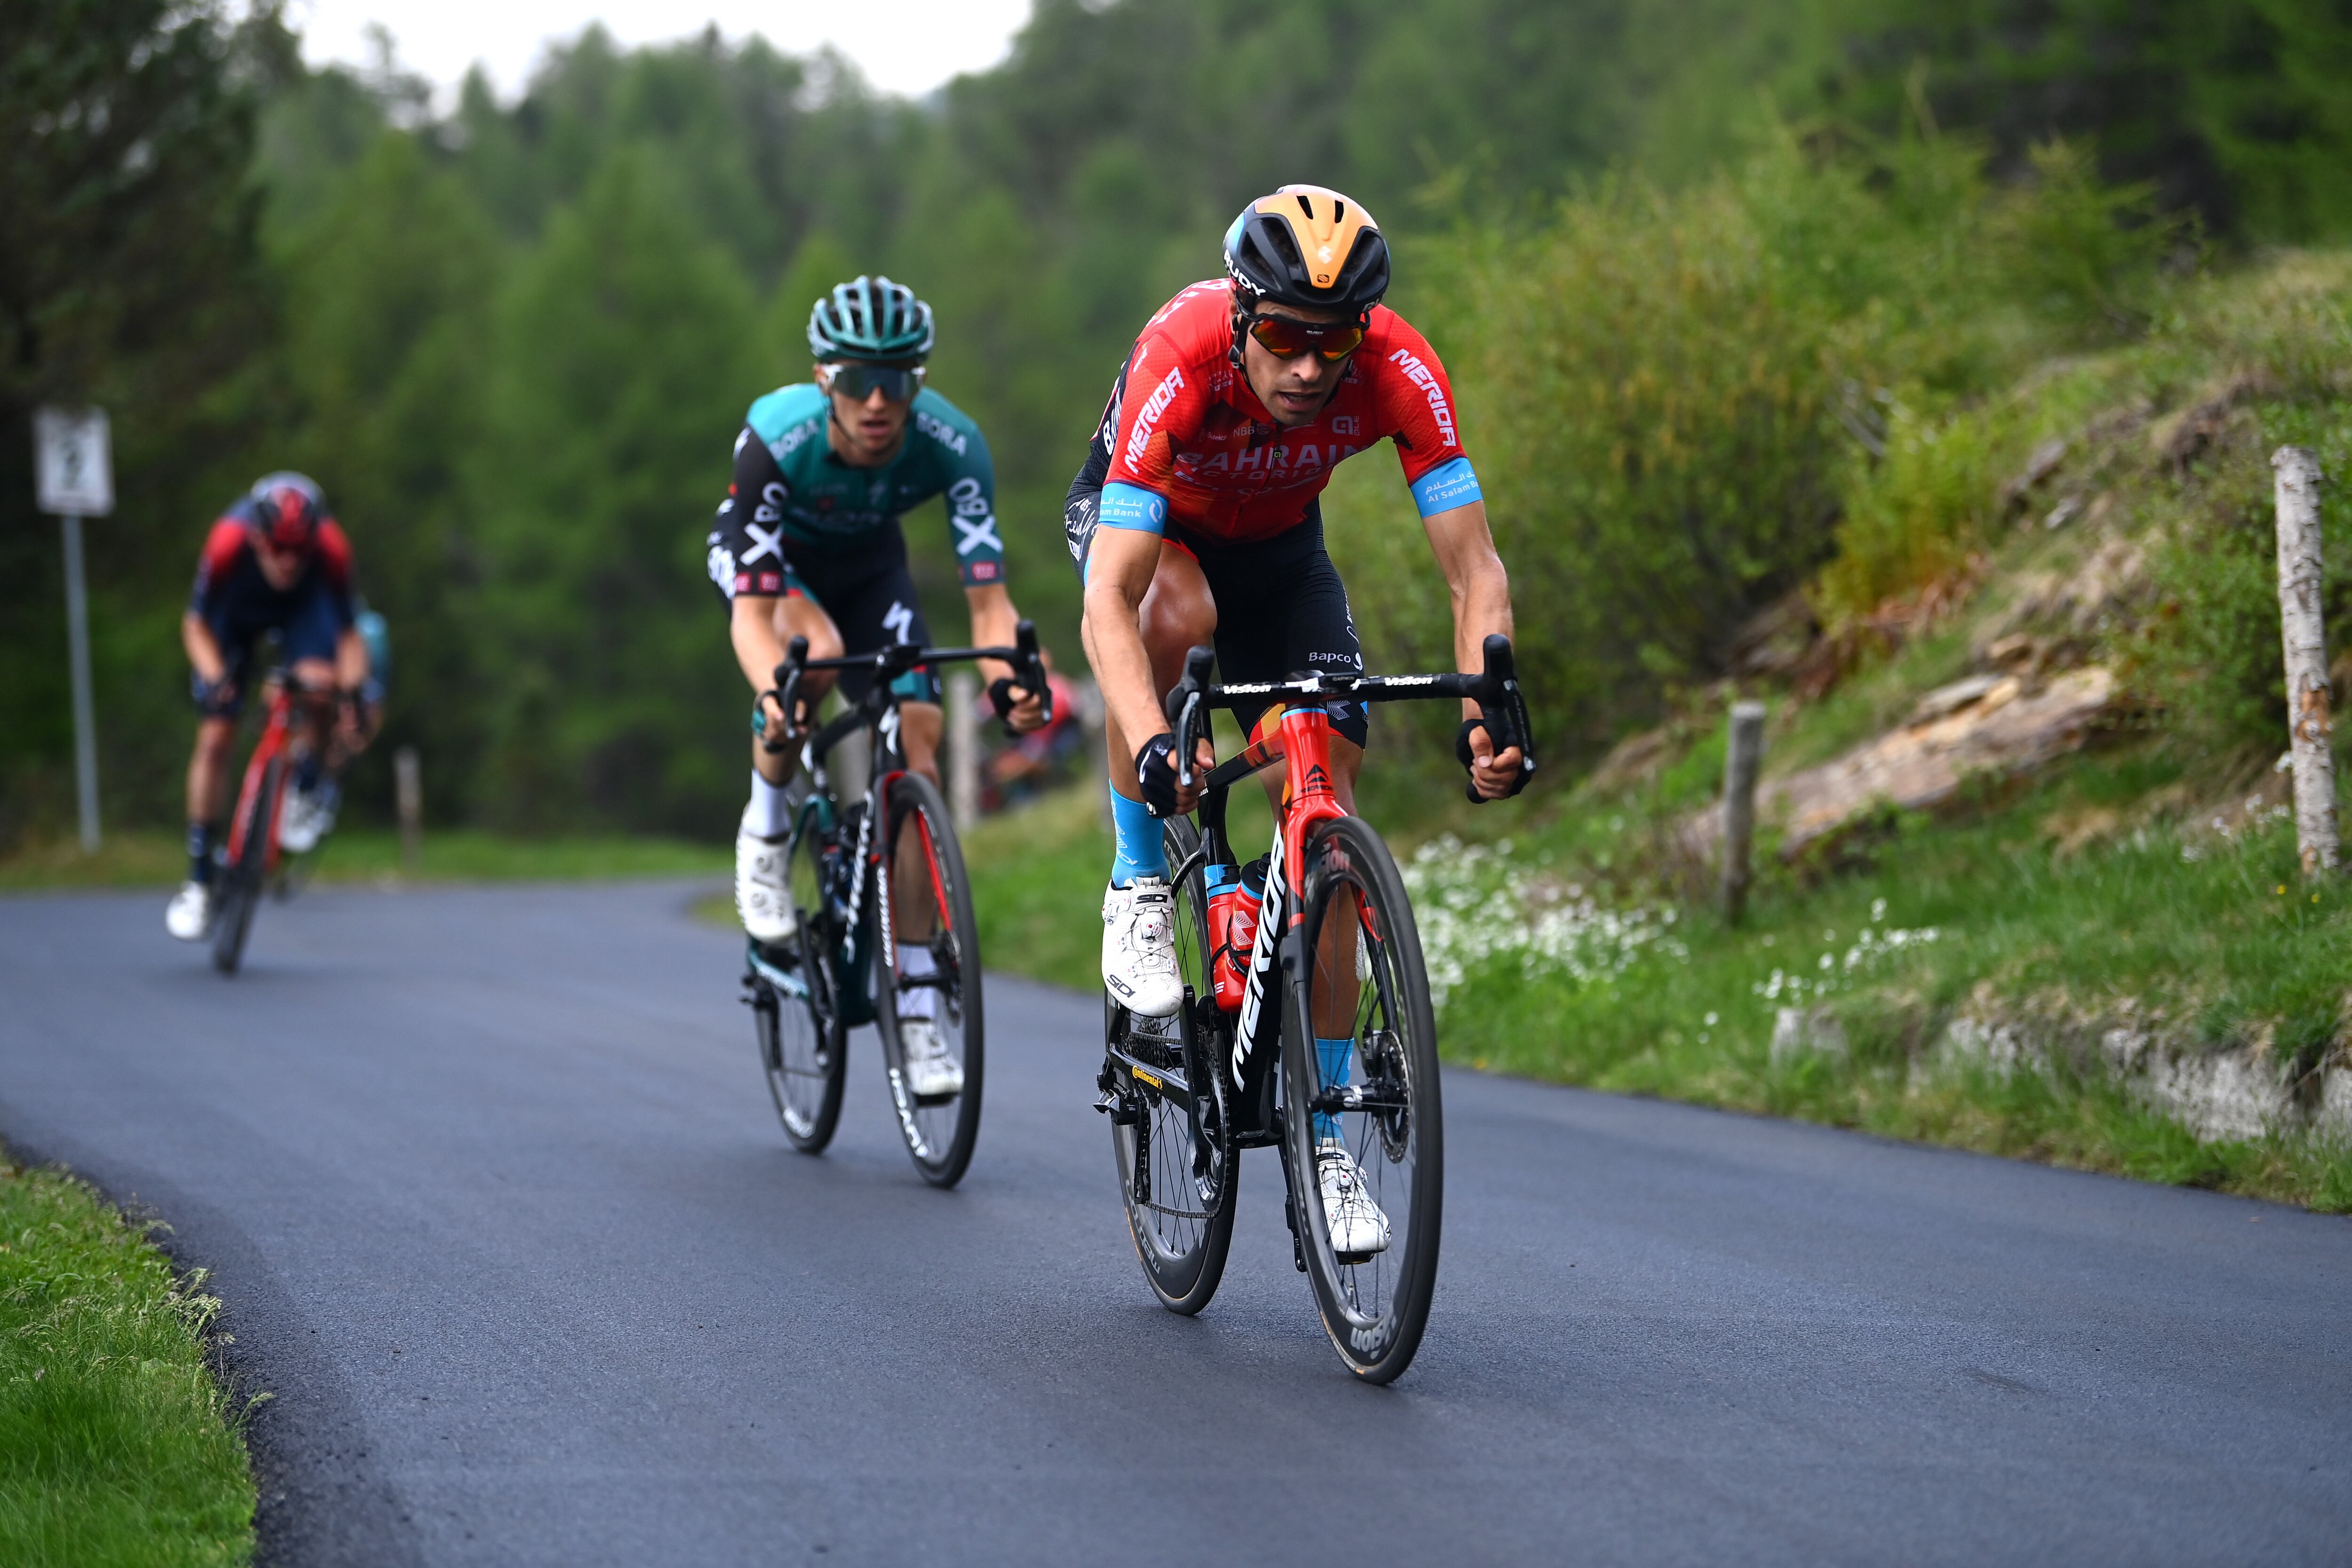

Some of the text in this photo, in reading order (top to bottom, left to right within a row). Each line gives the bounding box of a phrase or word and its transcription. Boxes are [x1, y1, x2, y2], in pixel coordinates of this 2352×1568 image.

[1224, 249, 1266, 296] RUDY
[1388, 348, 1456, 447] MERIDA
[1124, 366, 1184, 475] MERIDA
[1233, 426, 1255, 438] NBB
[769, 417, 818, 462] BORA
[916, 412, 967, 457] BORA
[1428, 494, 1439, 503] Al
[1441, 484, 1470, 499] Salam
[1113, 508, 1141, 517] Bank
[1308, 652, 1351, 663] Bapco
[1136, 894, 1168, 905] SIDI
[1232, 821, 1286, 1093] MERIDA
[1106, 974, 1136, 998] SIDI
[1132, 1065, 1159, 1089] Continental
